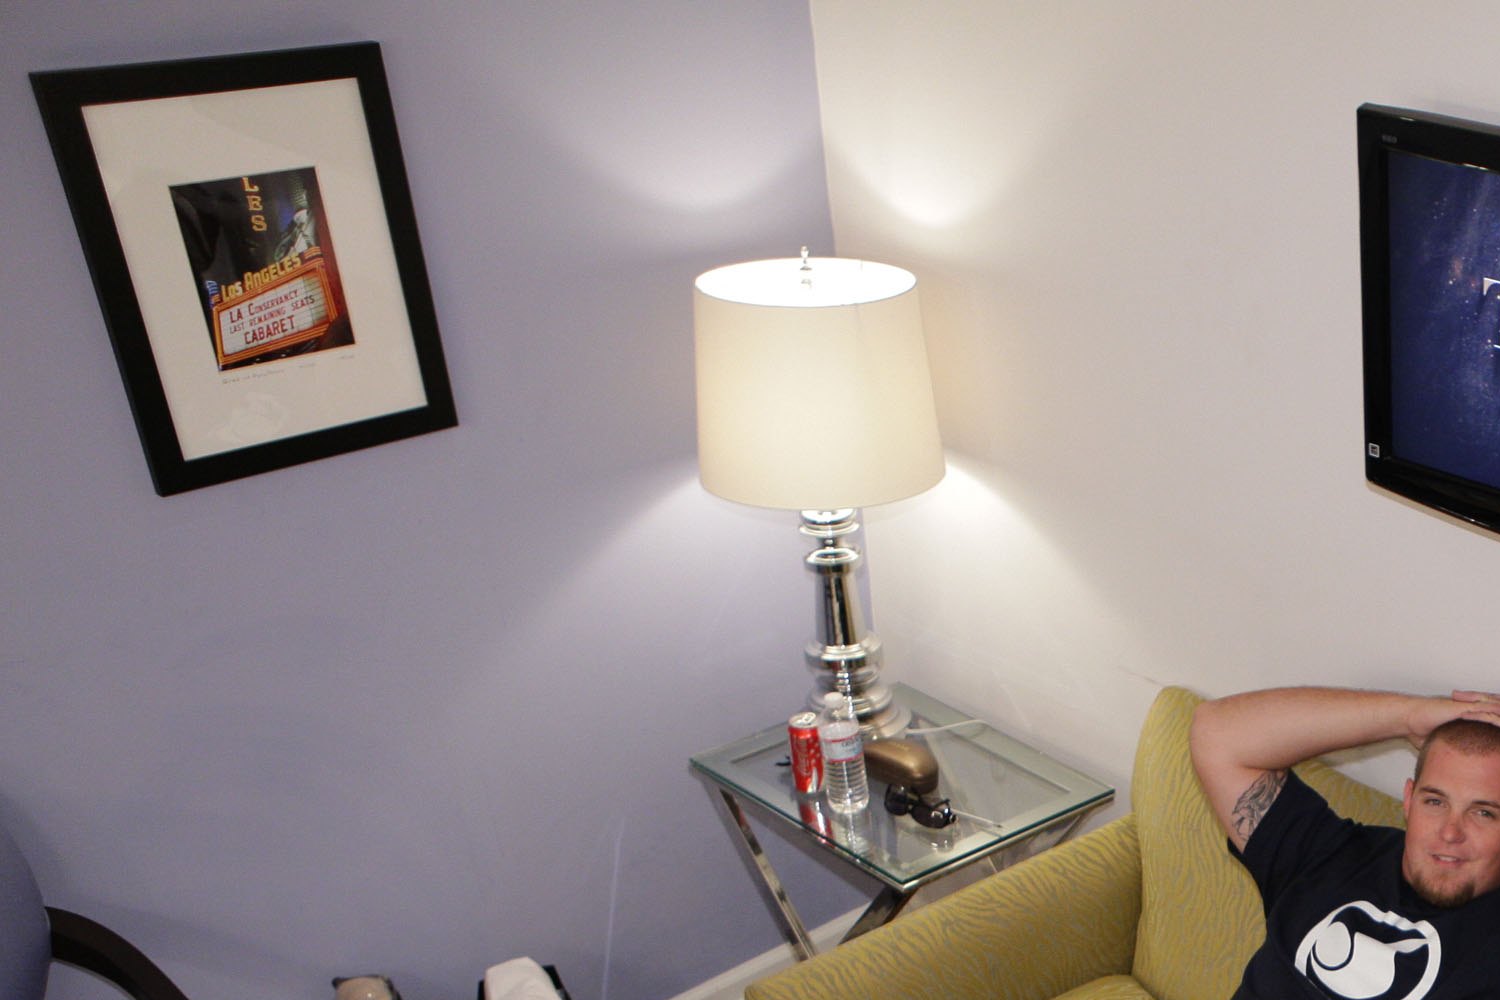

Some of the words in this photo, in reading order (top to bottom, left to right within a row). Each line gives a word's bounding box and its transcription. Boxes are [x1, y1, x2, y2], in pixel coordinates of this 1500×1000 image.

[244, 253, 302, 291] ANGELES
[229, 309, 244, 323] LA
[248, 289, 300, 316] CONSERVANCY
[229, 319, 246, 334] LAST
[249, 307, 287, 329] REMAINING
[291, 295, 316, 312] SEATS
[244, 315, 296, 345] CABARET
